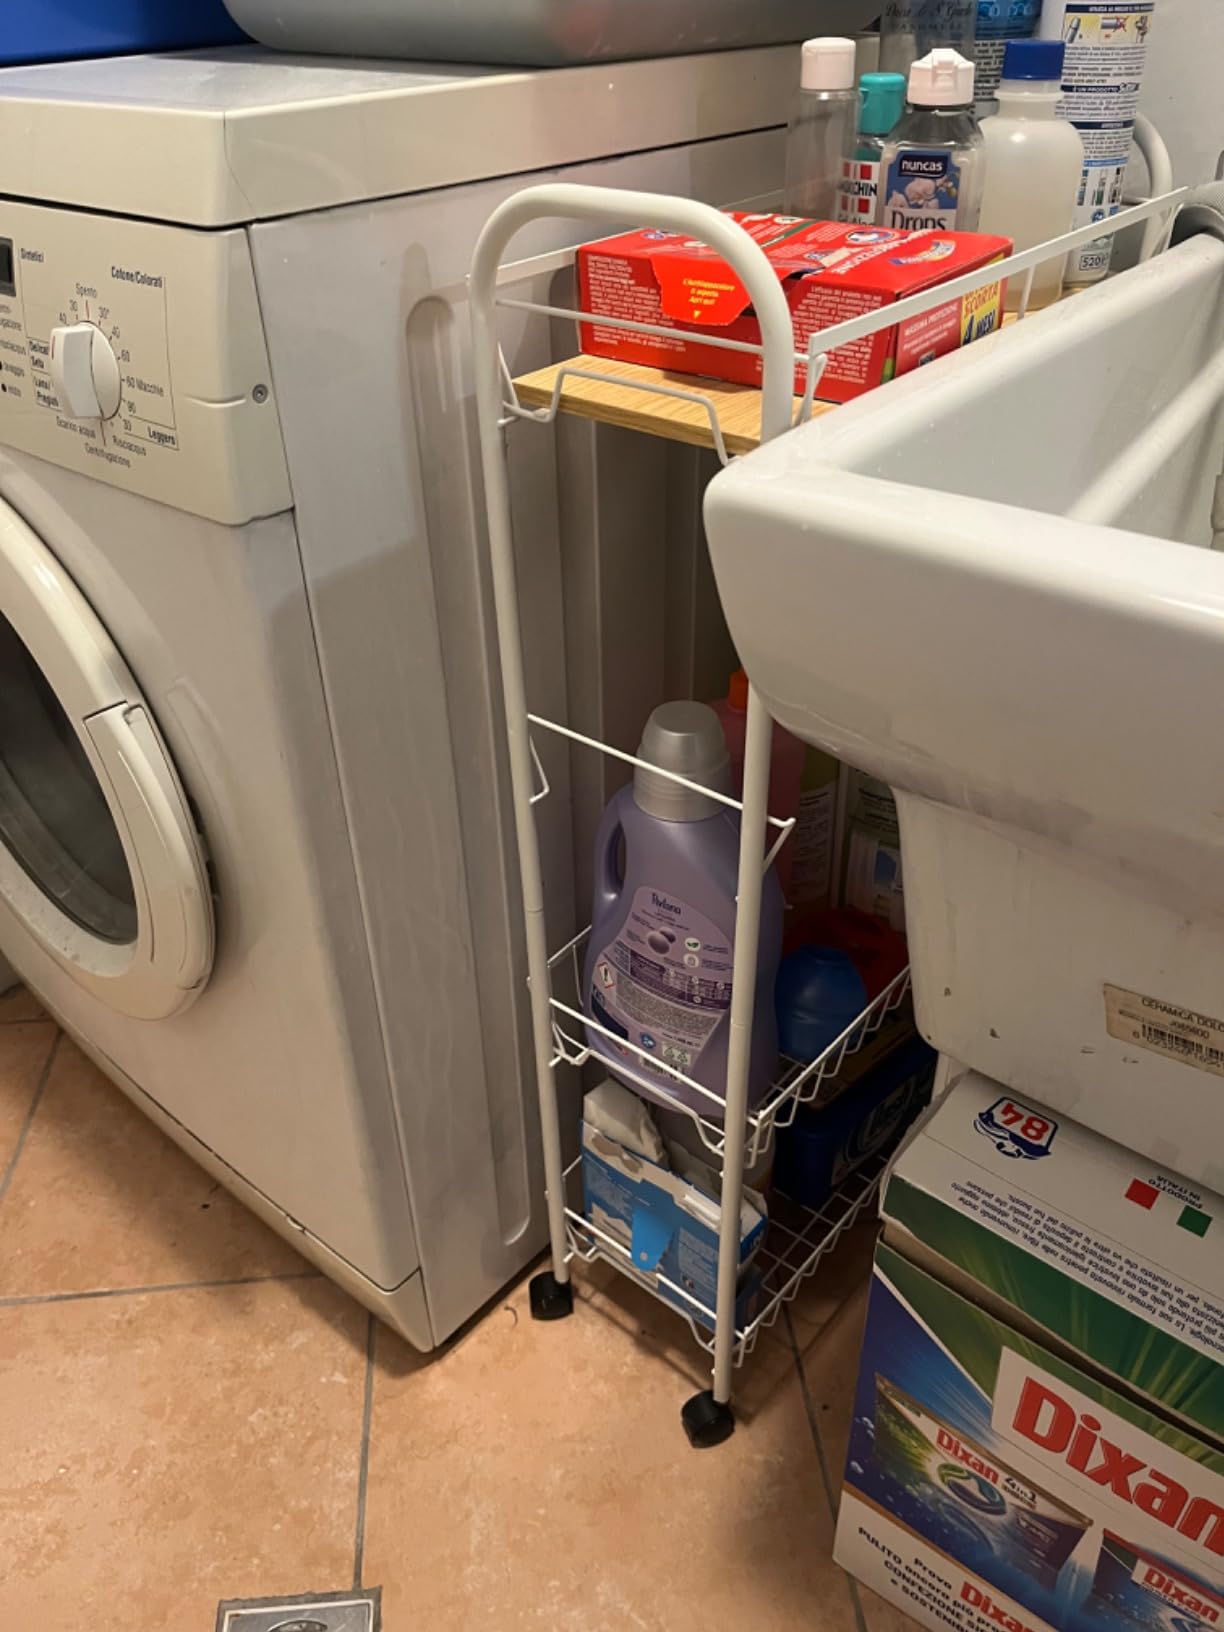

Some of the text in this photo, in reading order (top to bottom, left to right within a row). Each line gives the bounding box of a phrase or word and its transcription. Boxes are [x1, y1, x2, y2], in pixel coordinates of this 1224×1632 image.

[902, 160, 943, 172] nuncas
[892, 210, 948, 231] Drops
[1082, 255, 1100, 268] 520
[1001, 1103, 1049, 1141] 84
[1147, 1177, 1202, 1209] PRODOTTO
[1155, 1174, 1188, 1194] ITALIA
[1086, 1259, 1121, 1282] lavatrice
[1122, 1257, 1139, 1270] che
[936, 1428, 999, 1485] Dixan
[1013, 1376, 1224, 1556] Dixan
[858, 1526, 902, 1564] PULITO
[904, 1565, 950, 1600] ancora
[914, 1557, 952, 1590] Prova
[884, 1560, 963, 1623] CONFEZIONE
[1143, 1566, 1219, 1623] Dixan
